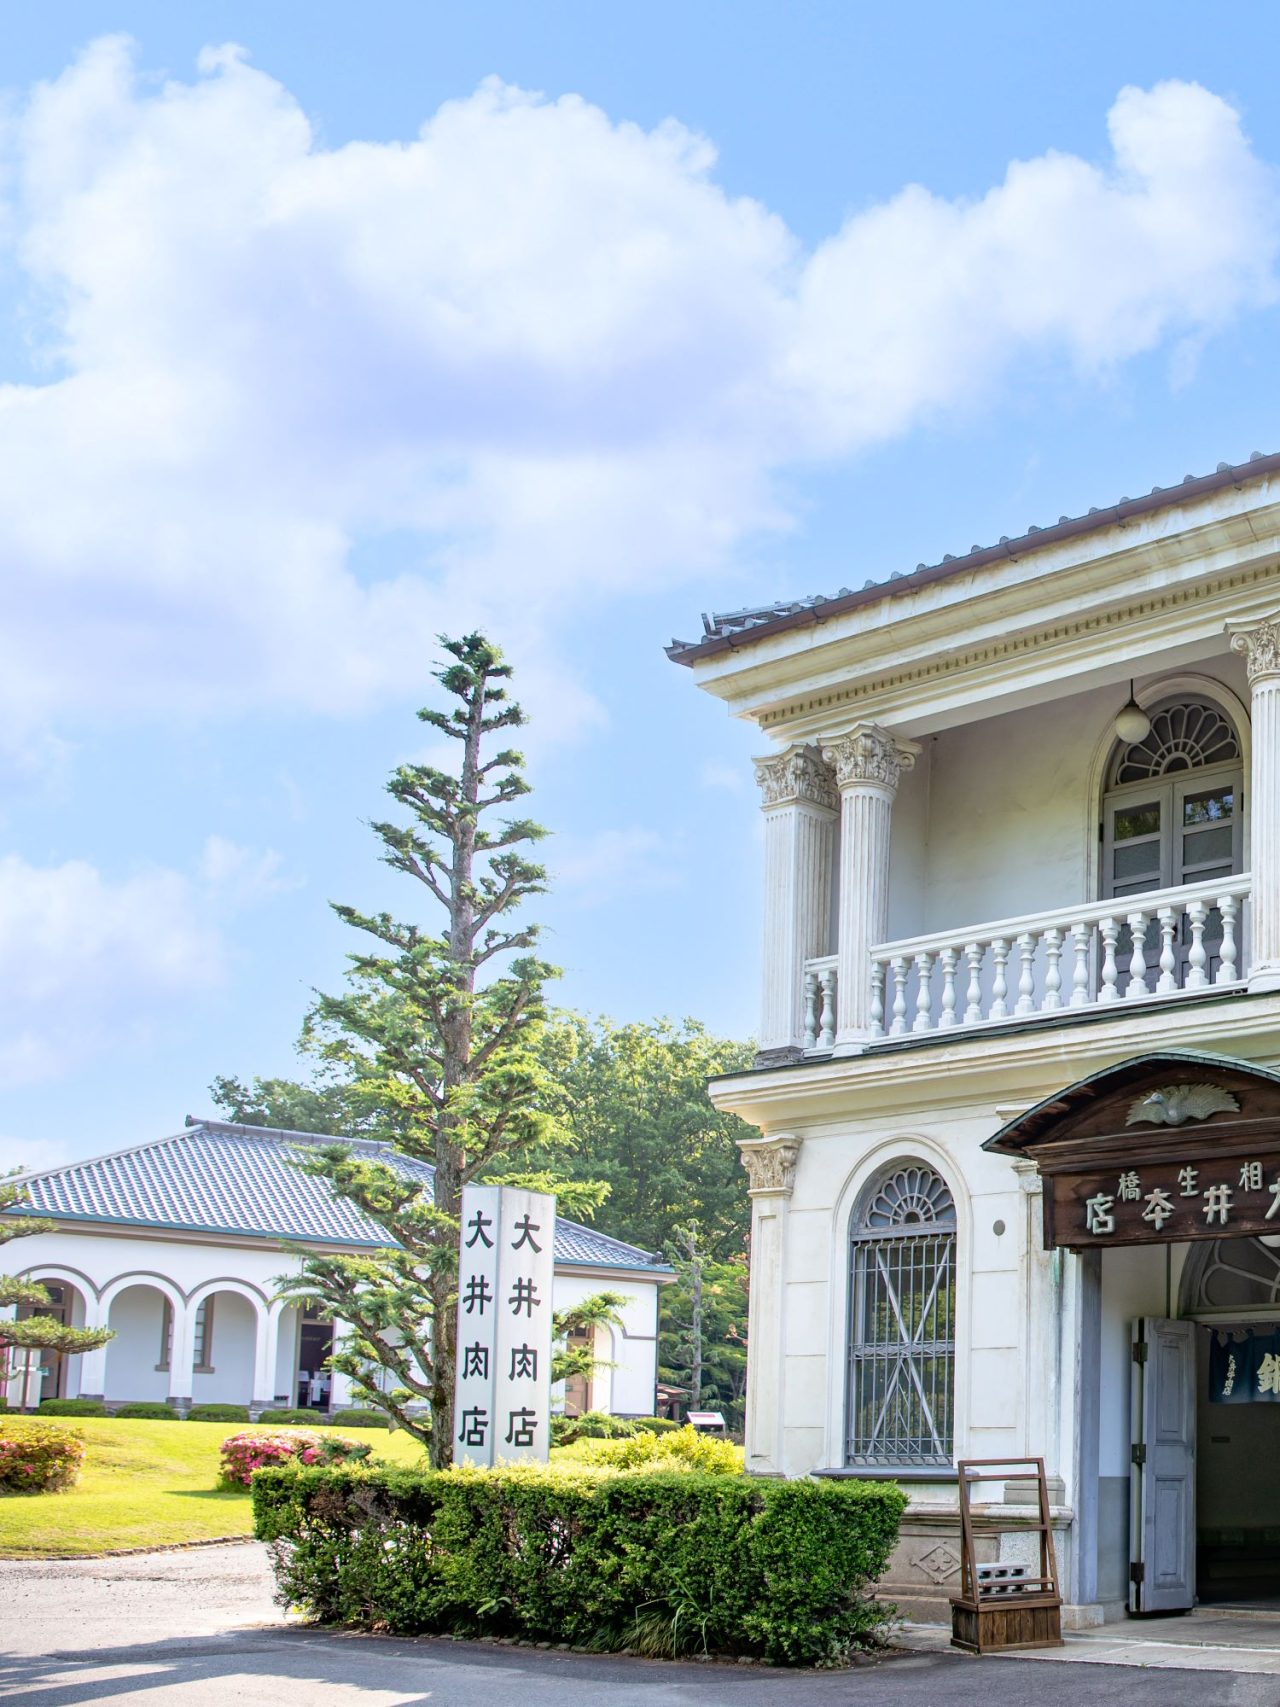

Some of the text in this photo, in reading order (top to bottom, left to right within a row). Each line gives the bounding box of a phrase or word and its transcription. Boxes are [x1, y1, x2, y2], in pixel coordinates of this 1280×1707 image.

[458, 1210, 494, 1447] 大井肉店
[505, 1213, 543, 1447] 大井肉店
